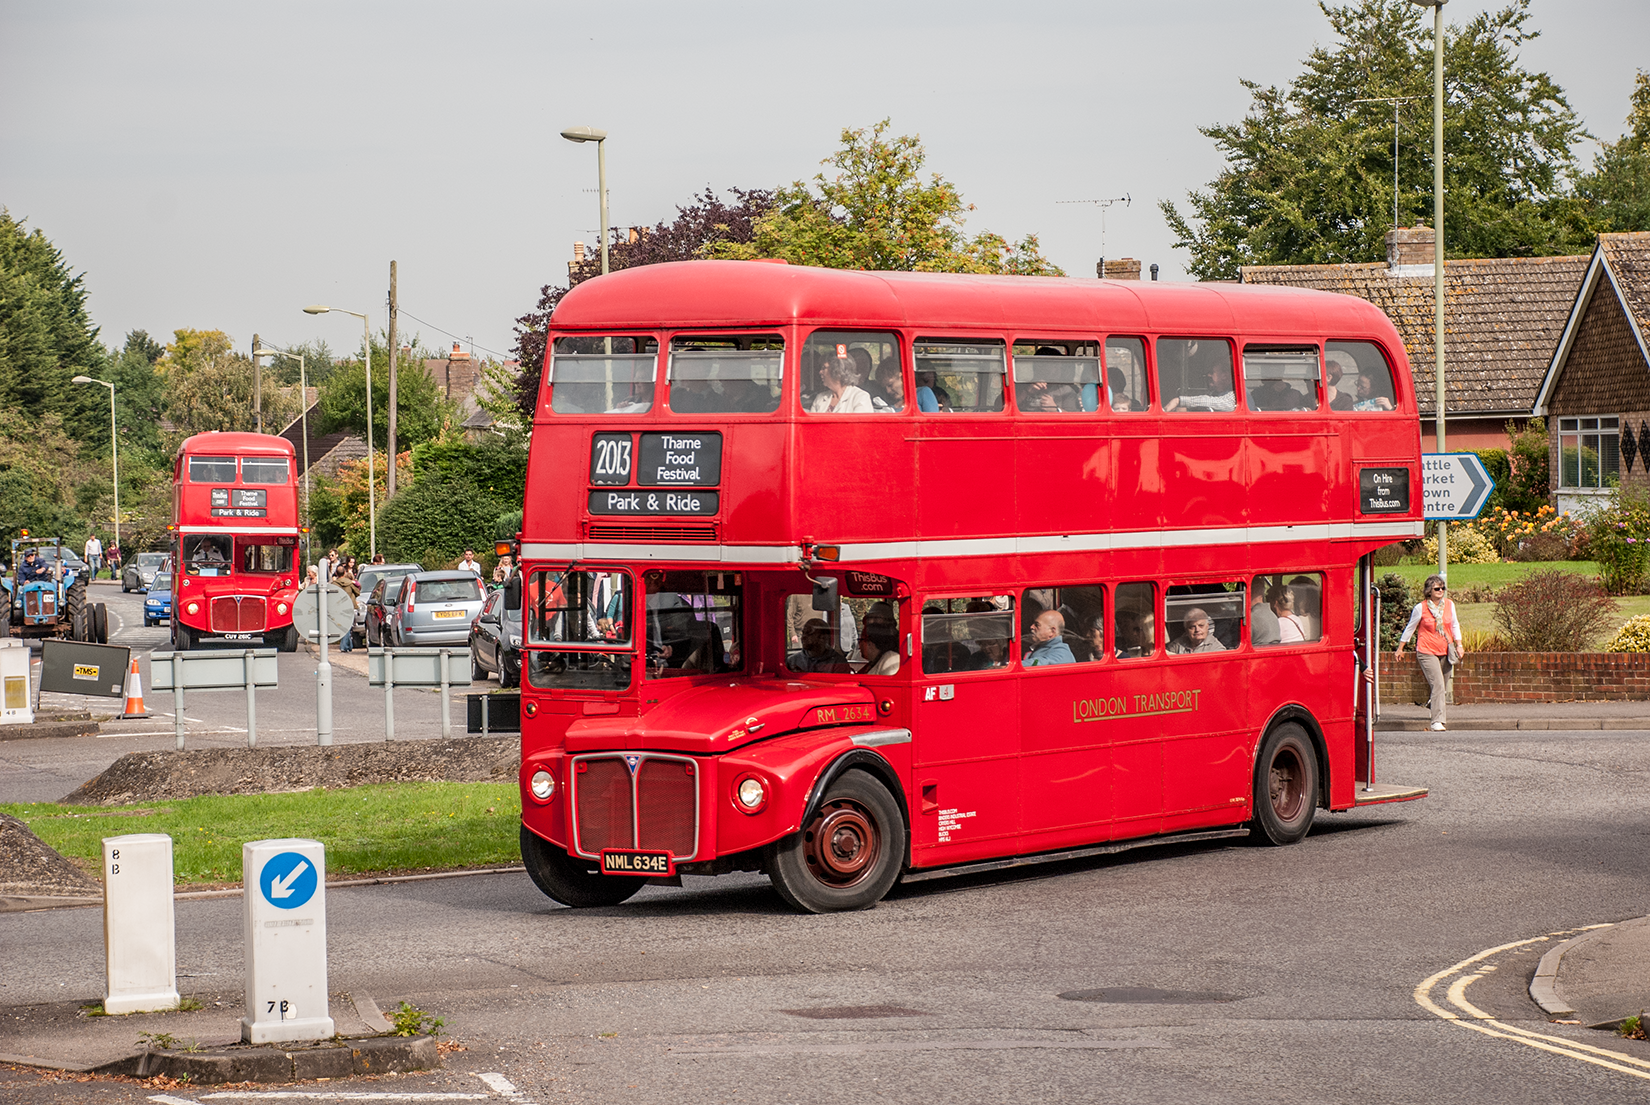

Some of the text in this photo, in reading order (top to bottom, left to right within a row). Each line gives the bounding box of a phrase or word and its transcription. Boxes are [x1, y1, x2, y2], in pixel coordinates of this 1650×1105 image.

[661, 436, 701, 449] Thame
[596, 440, 631, 475] 2013
[666, 451, 694, 464] Food
[657, 467, 700, 480] Festival
[1373, 474, 1393, 483] On Hire
[1377, 486, 1391, 496] from
[607, 493, 700, 511] Park & Ride
[1369, 498, 1400, 508] ThisBus.com
[1424, 501, 1455, 512] ntre
[244, 509, 260, 517] Ride
[851, 572, 888, 583] ThisBus
[861, 583, 884, 591] .com
[925, 687, 937, 700] AF
[1073, 689, 1201, 723] LONDON TRANSPORT
[817, 707, 870, 722] RML 2634
[112, 849, 120, 860] 8
[605, 854, 667, 871] NML634E
[112, 864, 120, 875] B
[267, 1000, 289, 1013] 7 B
